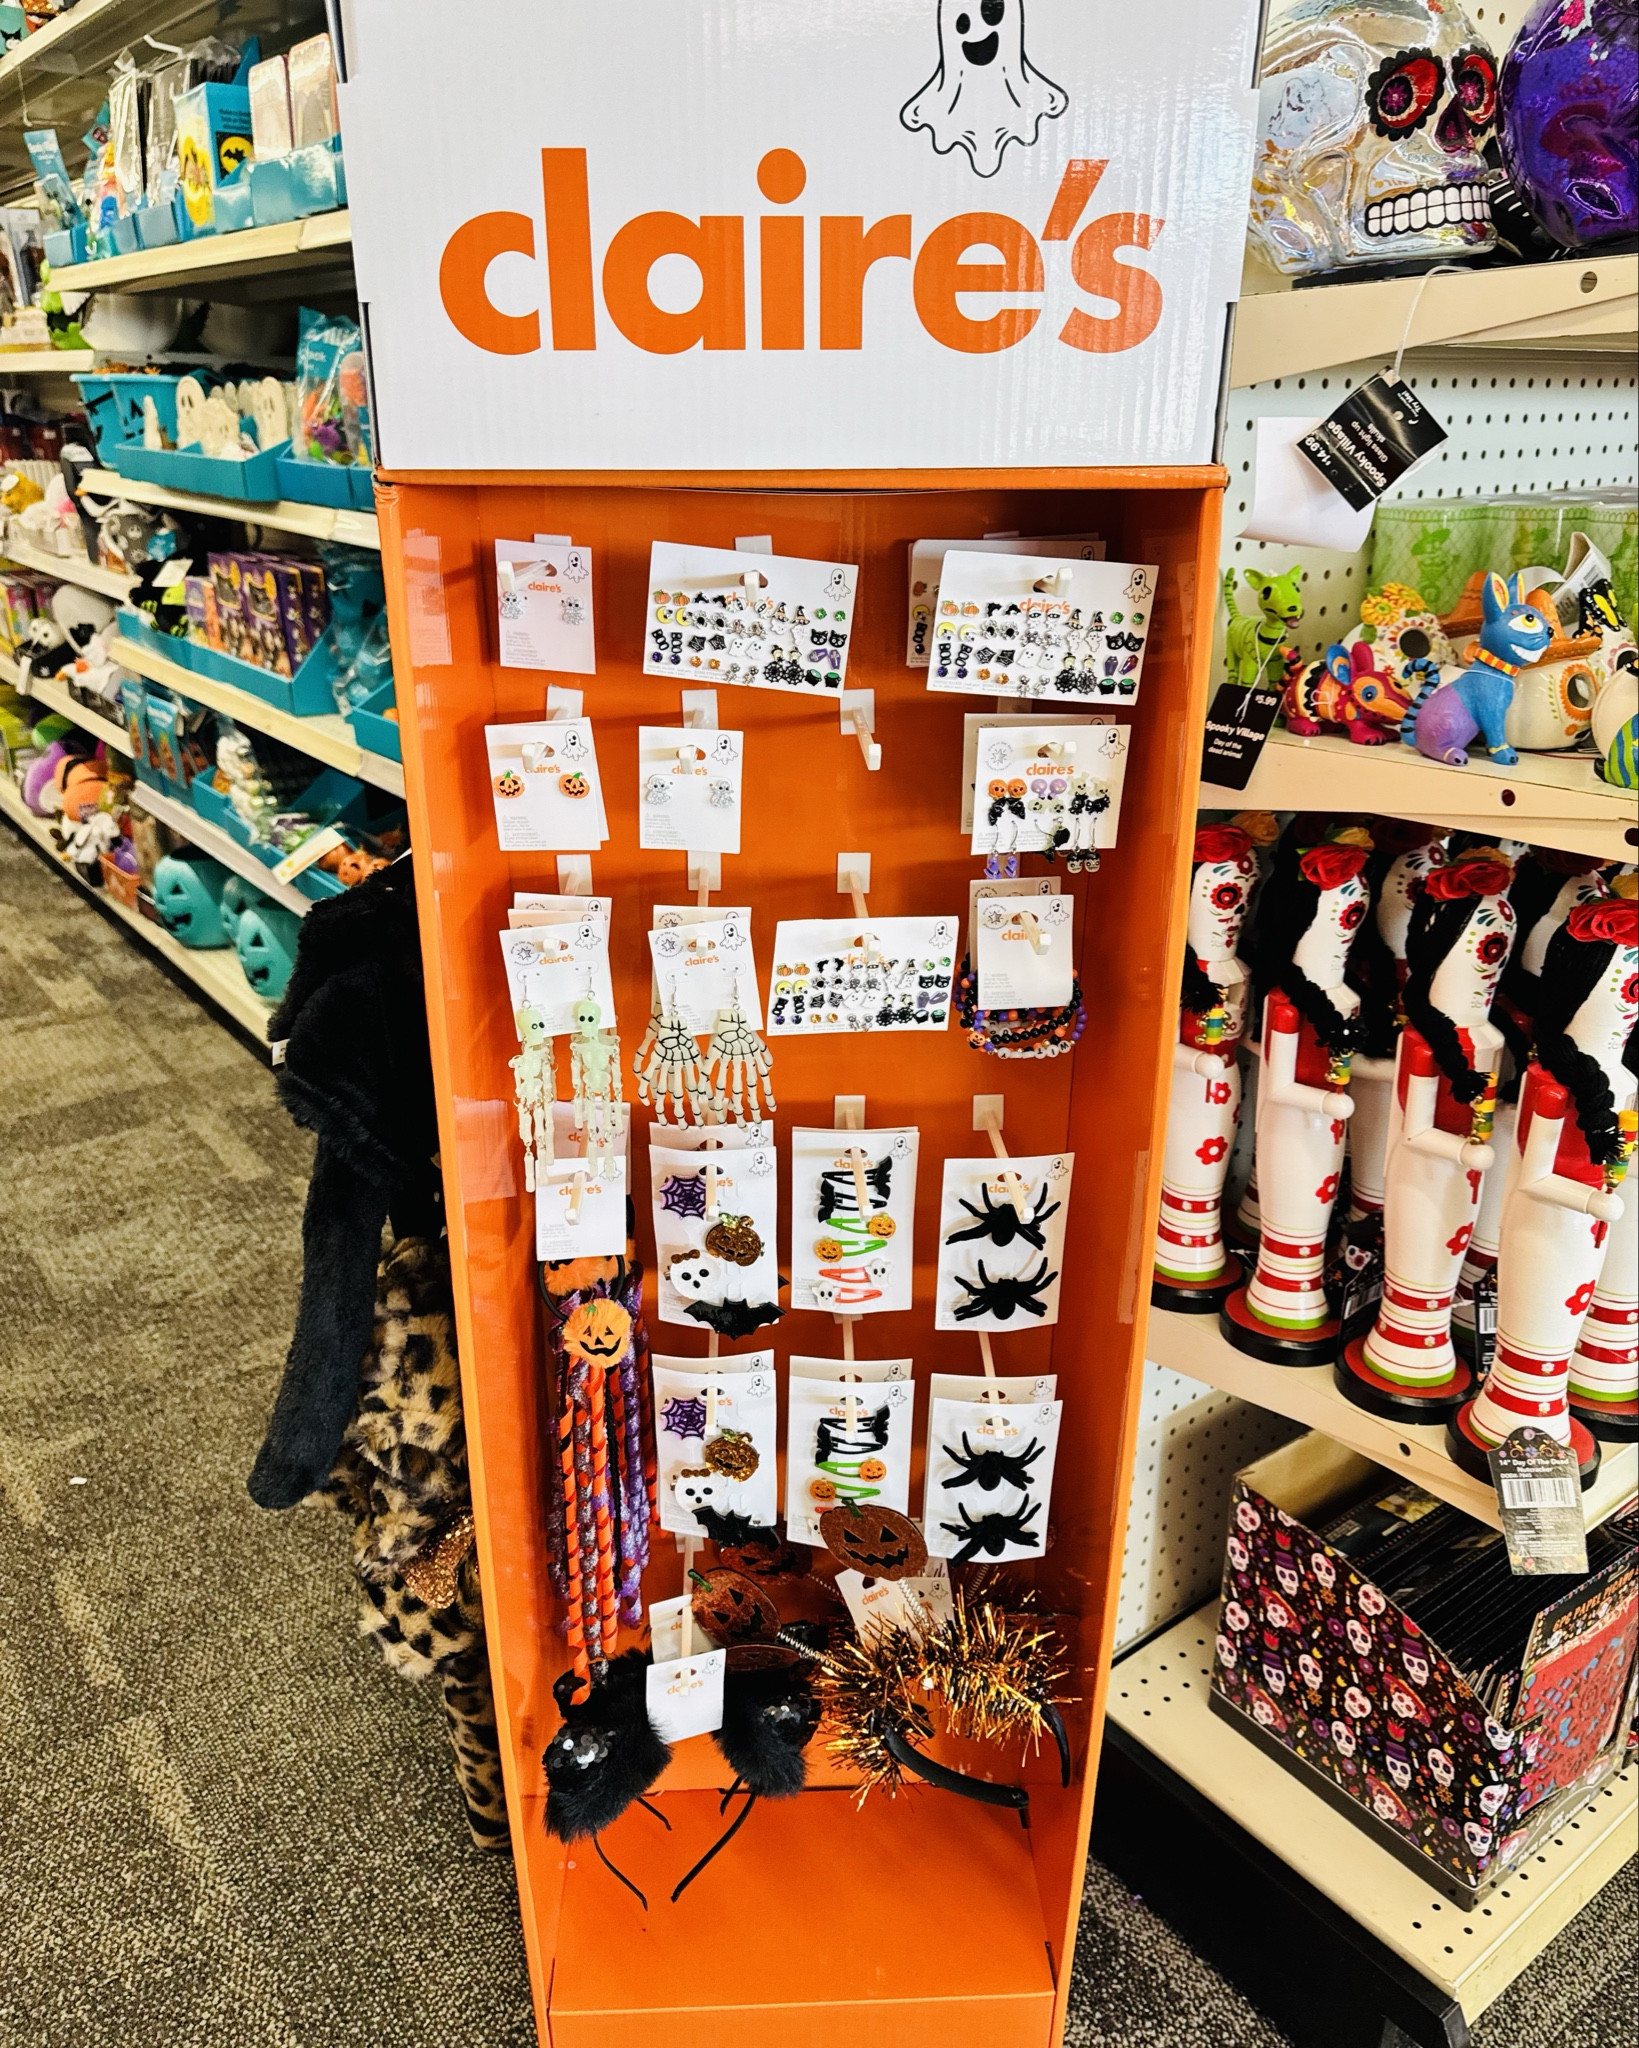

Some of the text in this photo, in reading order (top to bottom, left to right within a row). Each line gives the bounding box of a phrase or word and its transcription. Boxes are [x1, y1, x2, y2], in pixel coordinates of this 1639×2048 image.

[440, 147, 1166, 356] claire's
[1410, 401, 1422, 413] Try
[1367, 423, 1386, 443] skulls
[1305, 437, 1331, 466] $14.99
[1327, 421, 1387, 488] Spooky Village
[1371, 443, 1389, 463] Glass
[528, 582, 562, 593] claire's
[1255, 695, 1277, 706] $5.99
[1205, 720, 1265, 741] Spooky Village
[1213, 738, 1225, 747] Day
[539, 954, 575, 965] claire's
[685, 955, 720, 967] claire's
[1512, 1459, 1526, 1467] Day
